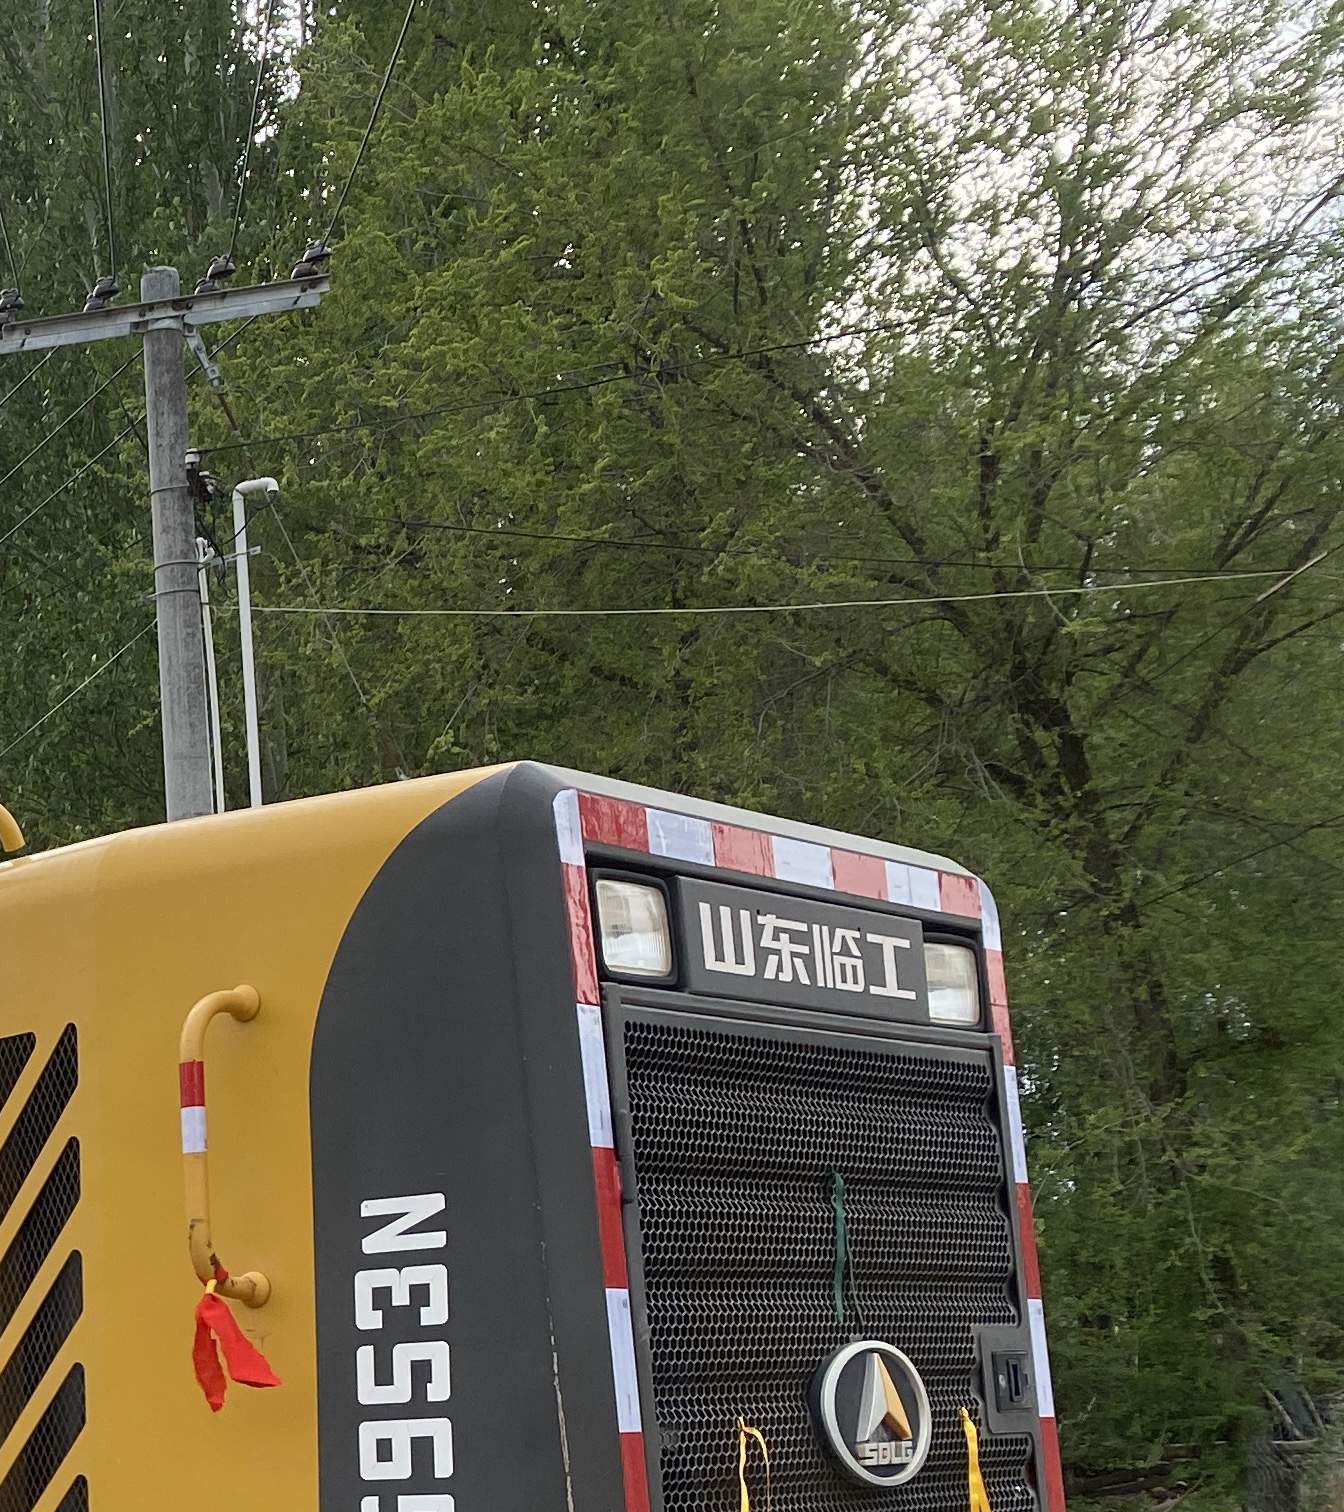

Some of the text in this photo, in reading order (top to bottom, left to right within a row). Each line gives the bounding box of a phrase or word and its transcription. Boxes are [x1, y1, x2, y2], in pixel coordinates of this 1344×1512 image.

[698, 901, 917, 1000] 山东临工
[857, 1441, 913, 1466] SDLG
